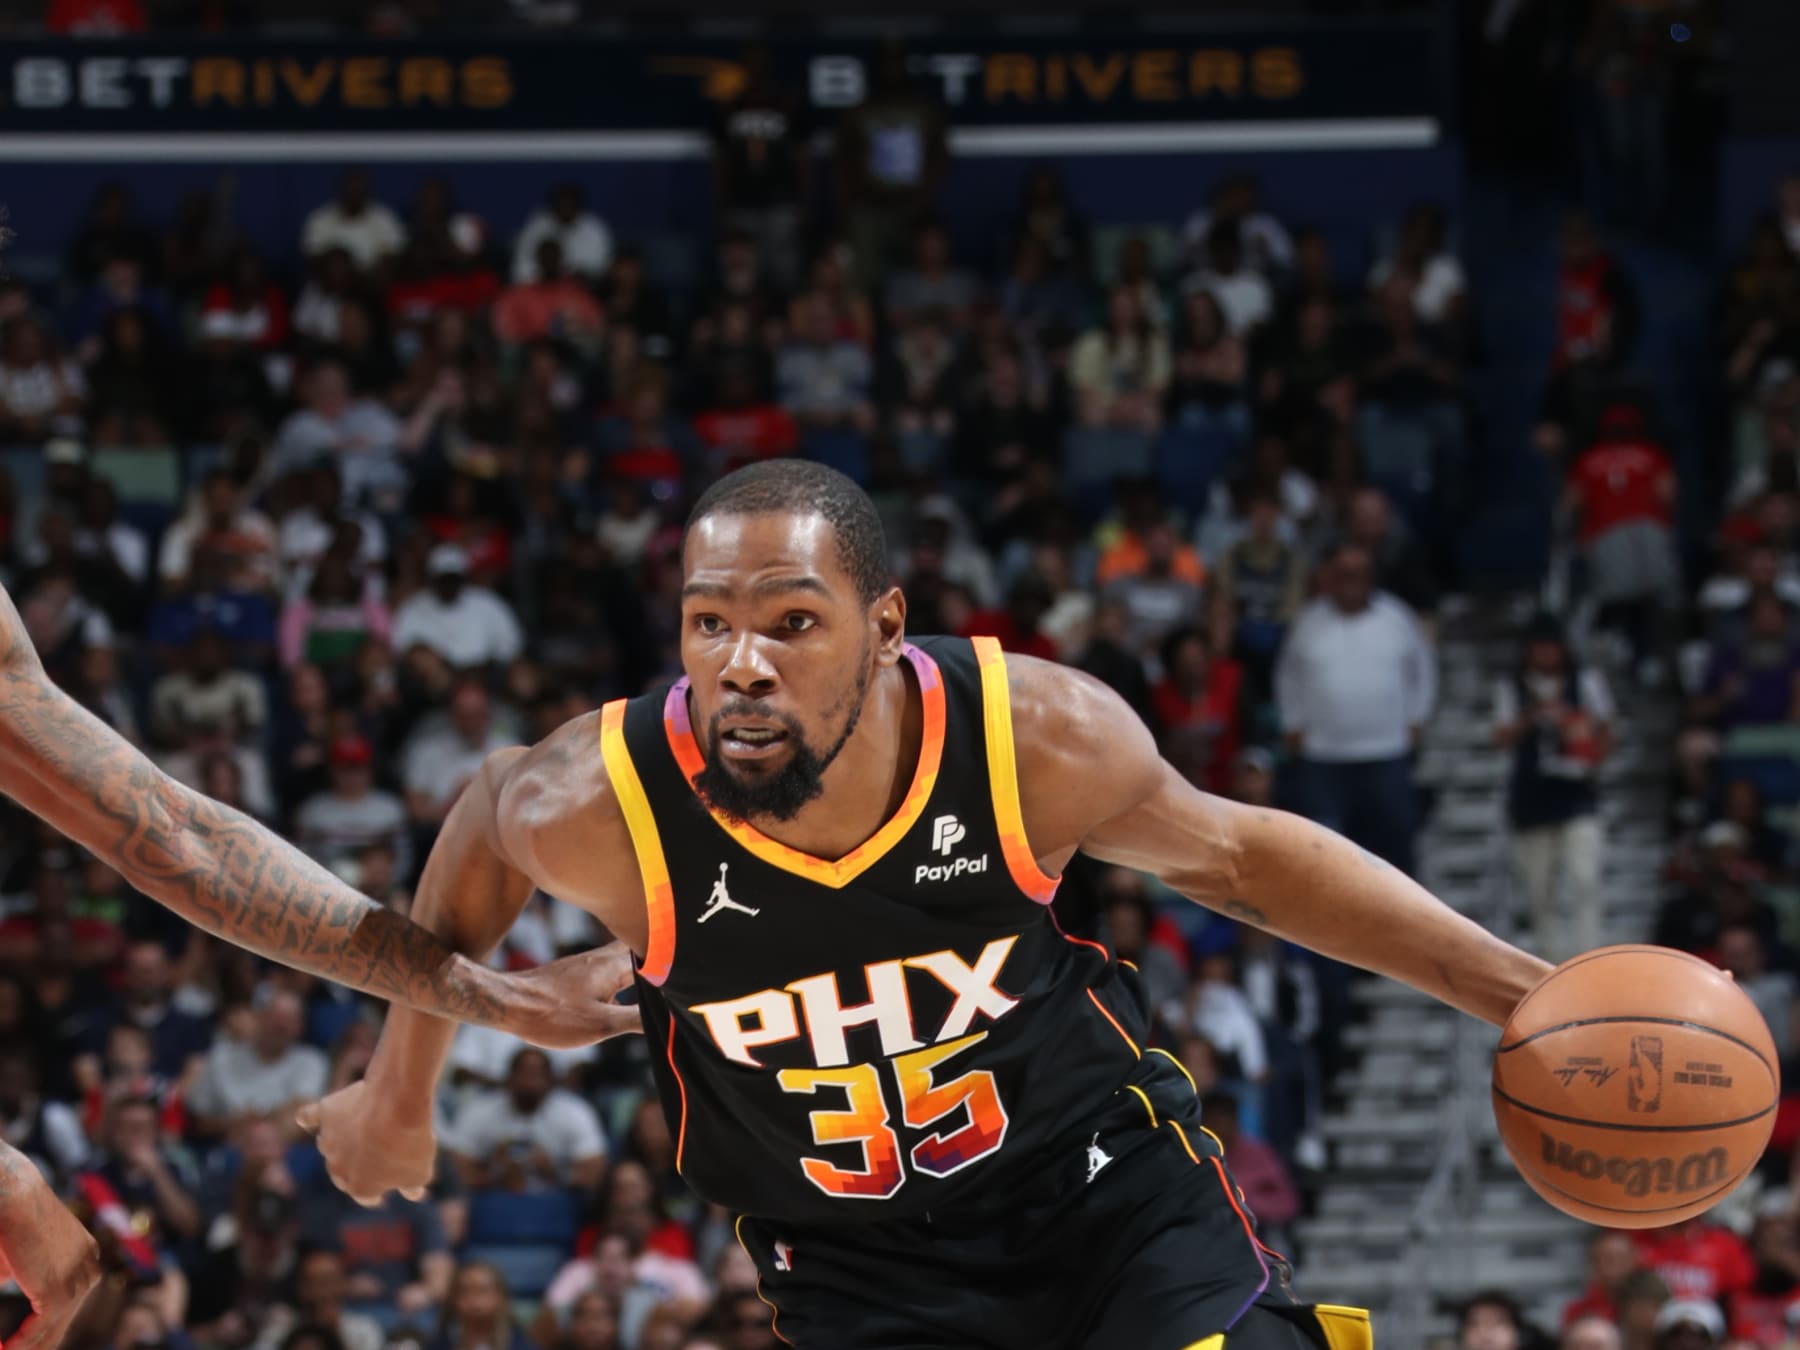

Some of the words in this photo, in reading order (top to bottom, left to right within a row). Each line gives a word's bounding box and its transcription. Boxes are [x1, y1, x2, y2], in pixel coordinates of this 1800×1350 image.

[11, 56, 513, 108] BETRIVERS
[808, 48, 1303, 105] BTRIVERS
[914, 853, 989, 884] PayPal
[688, 934, 1025, 1069] PHX
[776, 1030, 1010, 1200] 35
[1540, 1131, 1730, 1198] Wilson
